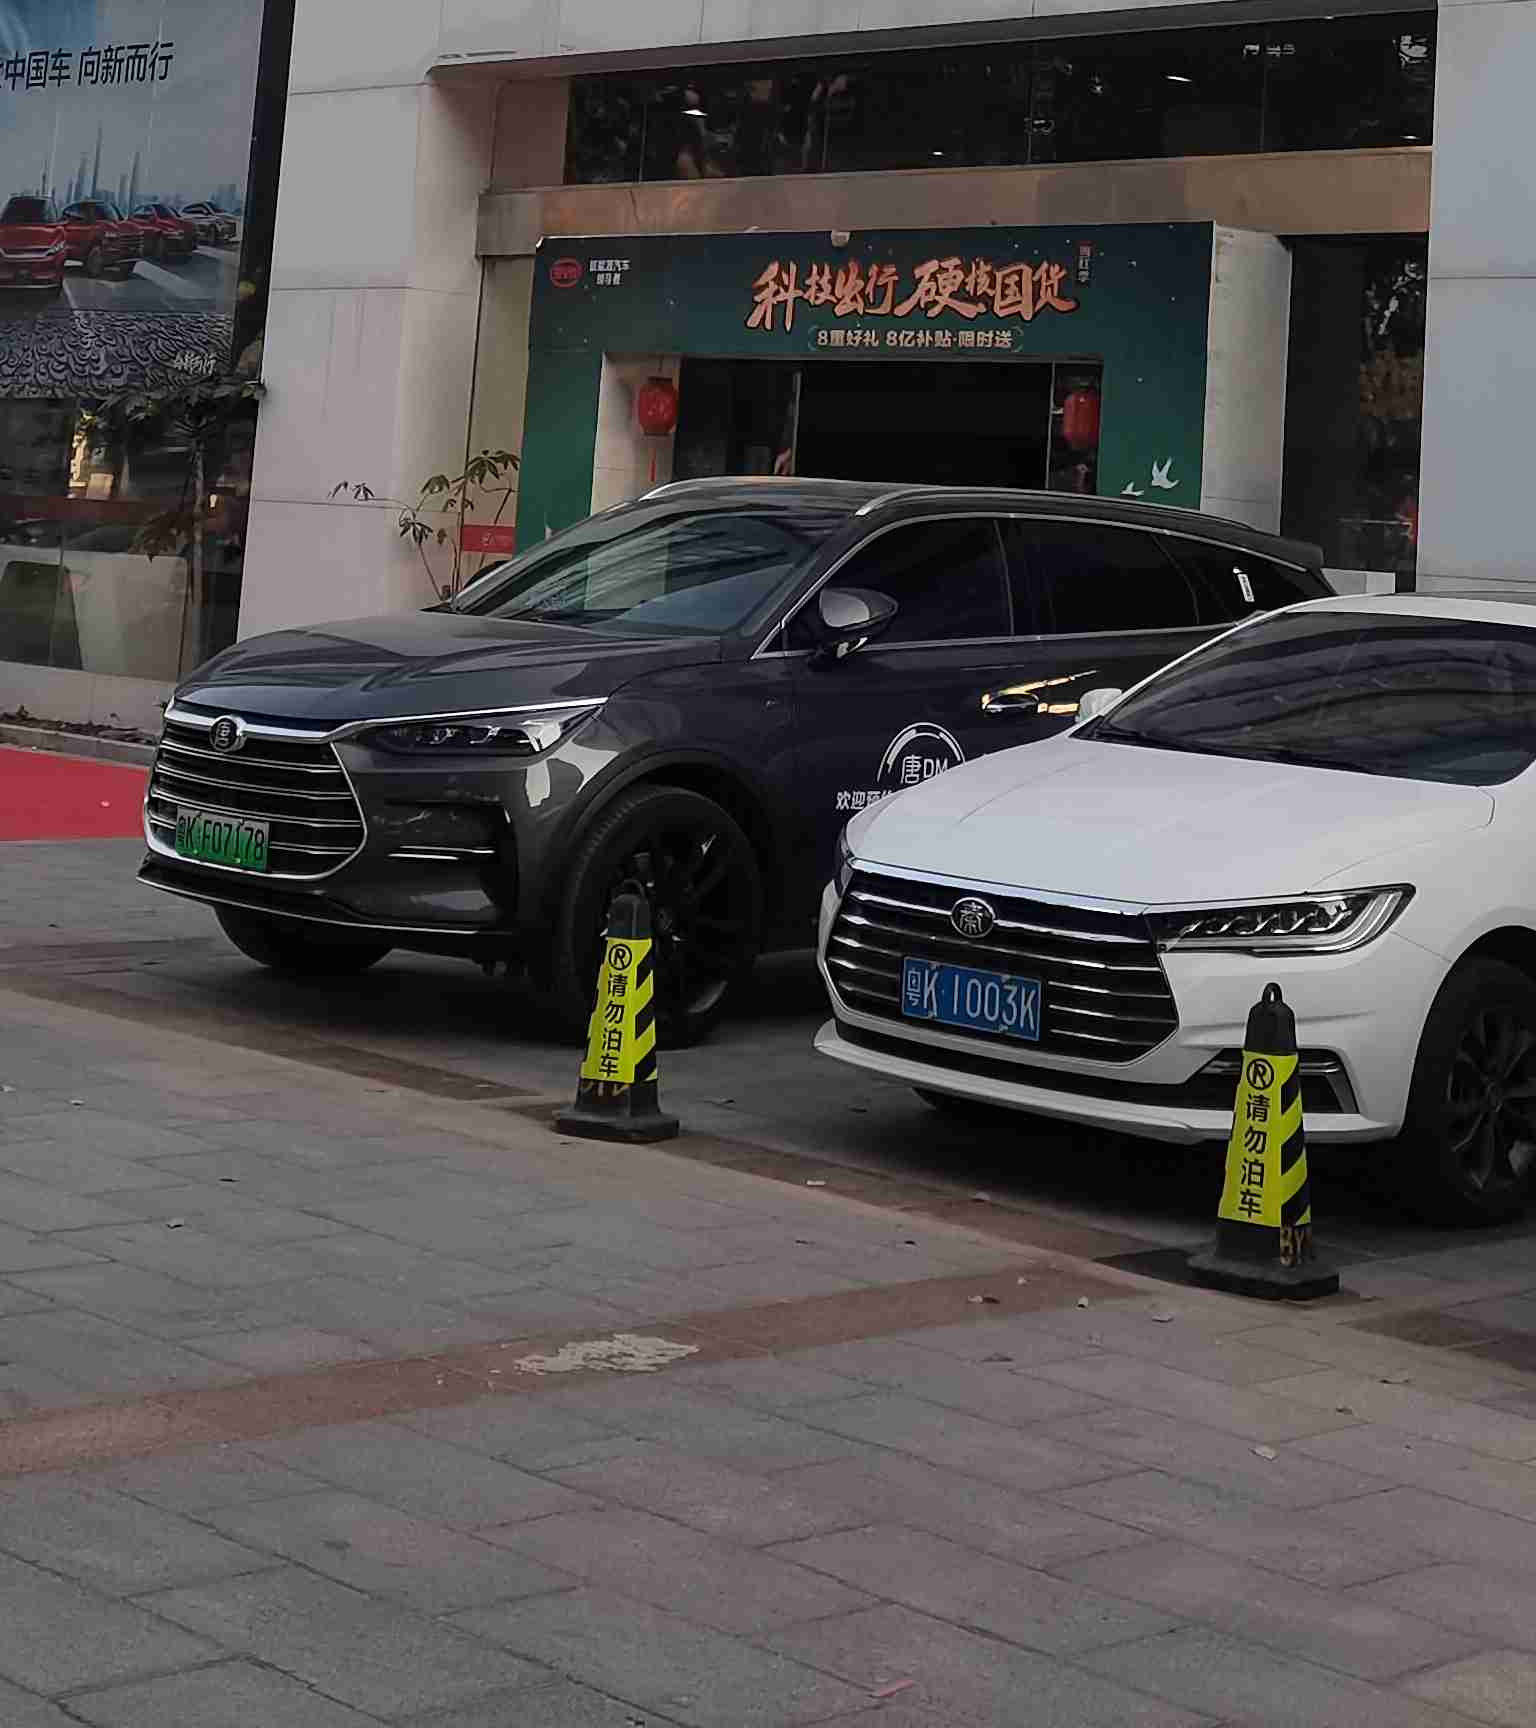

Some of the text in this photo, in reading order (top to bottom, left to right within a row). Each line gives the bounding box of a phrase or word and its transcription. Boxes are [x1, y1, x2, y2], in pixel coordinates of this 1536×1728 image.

[77, 40, 174, 87] 向新而行
[746, 257, 899, 332] 科技出行
[893, 255, 1081, 320] 硬核国货
[835, 788, 893, 811] 欢迎预
[901, 754, 949, 784] 唐DM
[599, 973, 628, 1077] 请勿泊车
[1238, 1093, 1271, 1219] 请勿泊车
